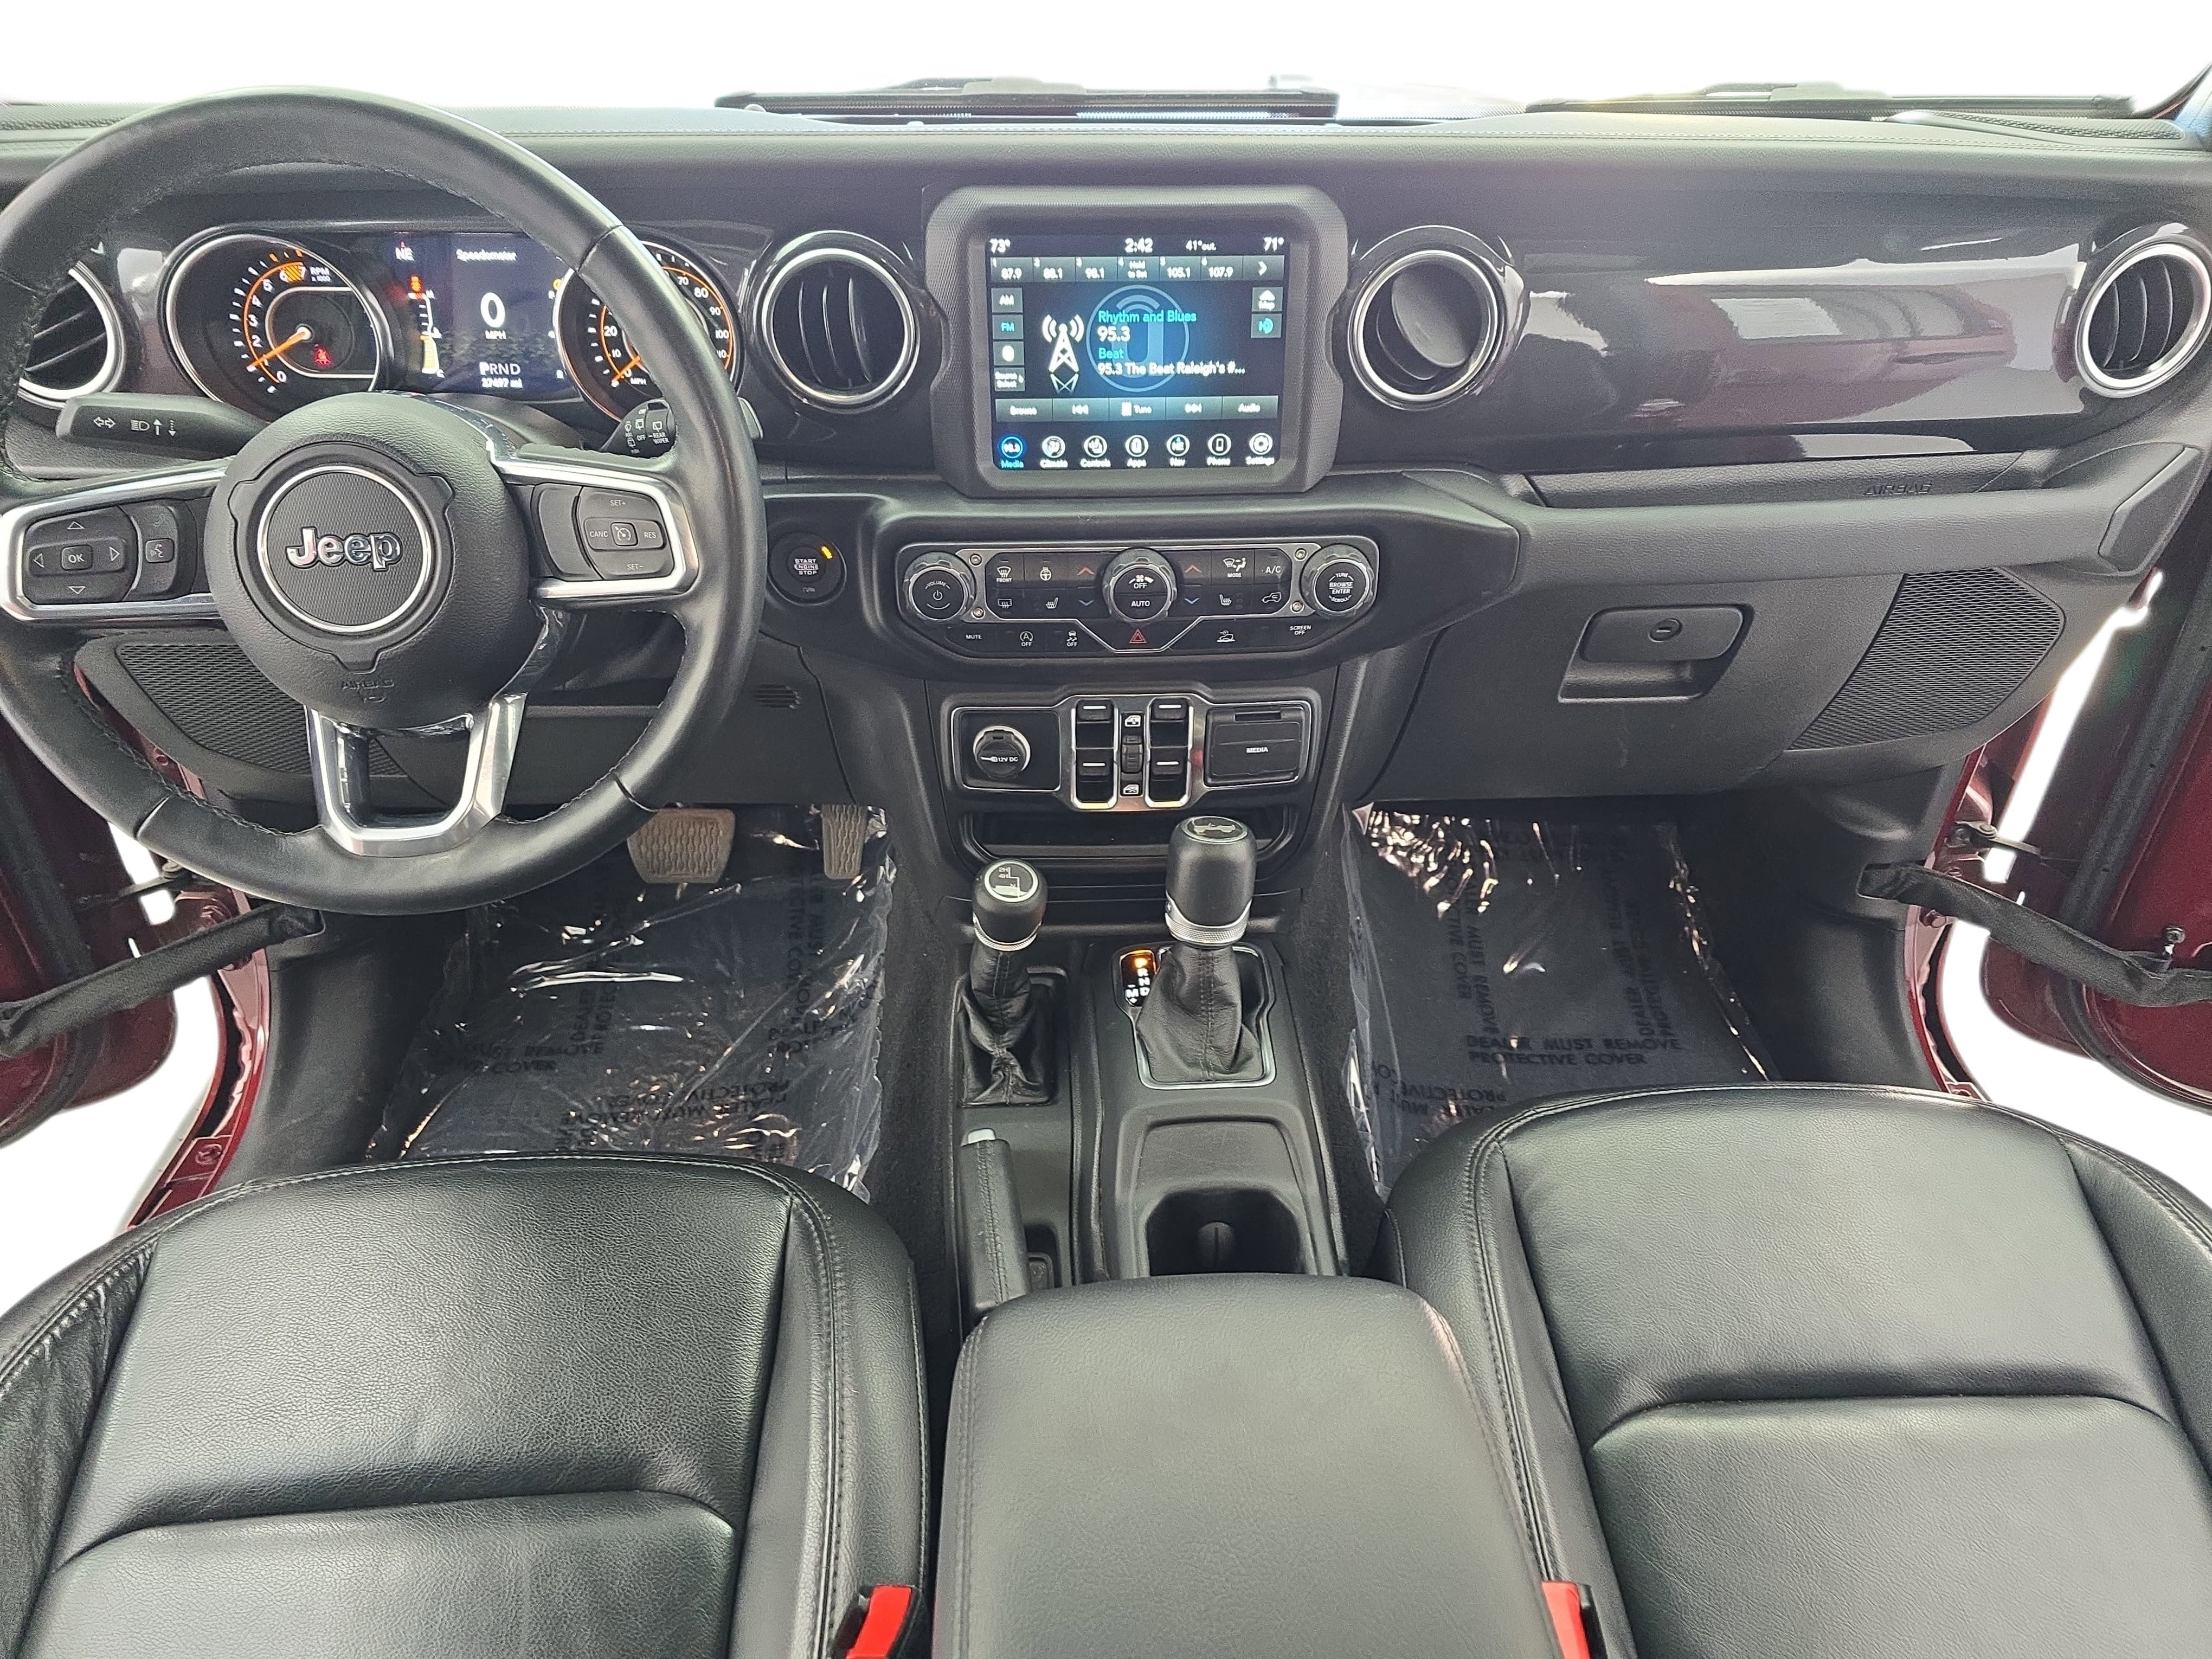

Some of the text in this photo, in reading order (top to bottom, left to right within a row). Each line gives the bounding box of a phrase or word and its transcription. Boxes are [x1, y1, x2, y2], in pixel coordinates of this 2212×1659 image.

[1125, 237, 1153, 253] 2:42
[395, 247, 414, 261] NE
[456, 249, 517, 261] Speedometer
[280, 270, 290, 282] 6
[298, 265, 306, 280] 7
[310, 267, 330, 276] RPM
[263, 279, 273, 292] 5
[678, 276, 689, 285] 70
[694, 287, 709, 298] 80
[252, 295, 262, 308] 4
[999, 295, 1014, 305] AM
[480, 292, 505, 328] 0
[710, 307, 721, 316] 90
[248, 314, 258, 327] 3
[1098, 310, 1197, 325] Rhythm and Blues
[603, 326, 618, 336] 20
[1001, 323, 1014, 332] FM
[485, 330, 506, 339] MPH
[715, 330, 729, 339] 100
[1097, 326, 1130, 342] 95.3
[252, 335, 263, 348] 2
[612, 349, 621, 358] 10
[1098, 348, 1124, 359] Beat
[623, 368, 632, 377] 0
[1097, 362, 1123, 375] 95.3
[1124, 362, 1146, 374] The
[1149, 362, 1174, 374] Beat
[1176, 360, 1225, 376] Raleigh's
[277, 371, 286, 383] 0
[1010, 406, 1037, 415] Browse
[1134, 404, 1153, 414] Tune
[1238, 402, 1261, 413] Audio
[1001, 460, 1024, 468] Media
[1040, 459, 1068, 468] Climate
[1080, 459, 1111, 468] Controls
[1127, 459, 1147, 468] Apps
[1169, 457, 1186, 466] Nav
[1206, 456, 1231, 466] Phone
[1246, 456, 1275, 466] Settings
[286, 527, 402, 570] Jeep
[69, 554, 85, 563] OK
[1139, 977, 1150, 986] N
[1126, 989, 1139, 998] M
[1140, 987, 1150, 996] D
[1543, 1037, 1594, 1051] MUST
[1602, 1037, 1684, 1051] REMOVE
[1584, 1052, 1644, 1066] COVER
